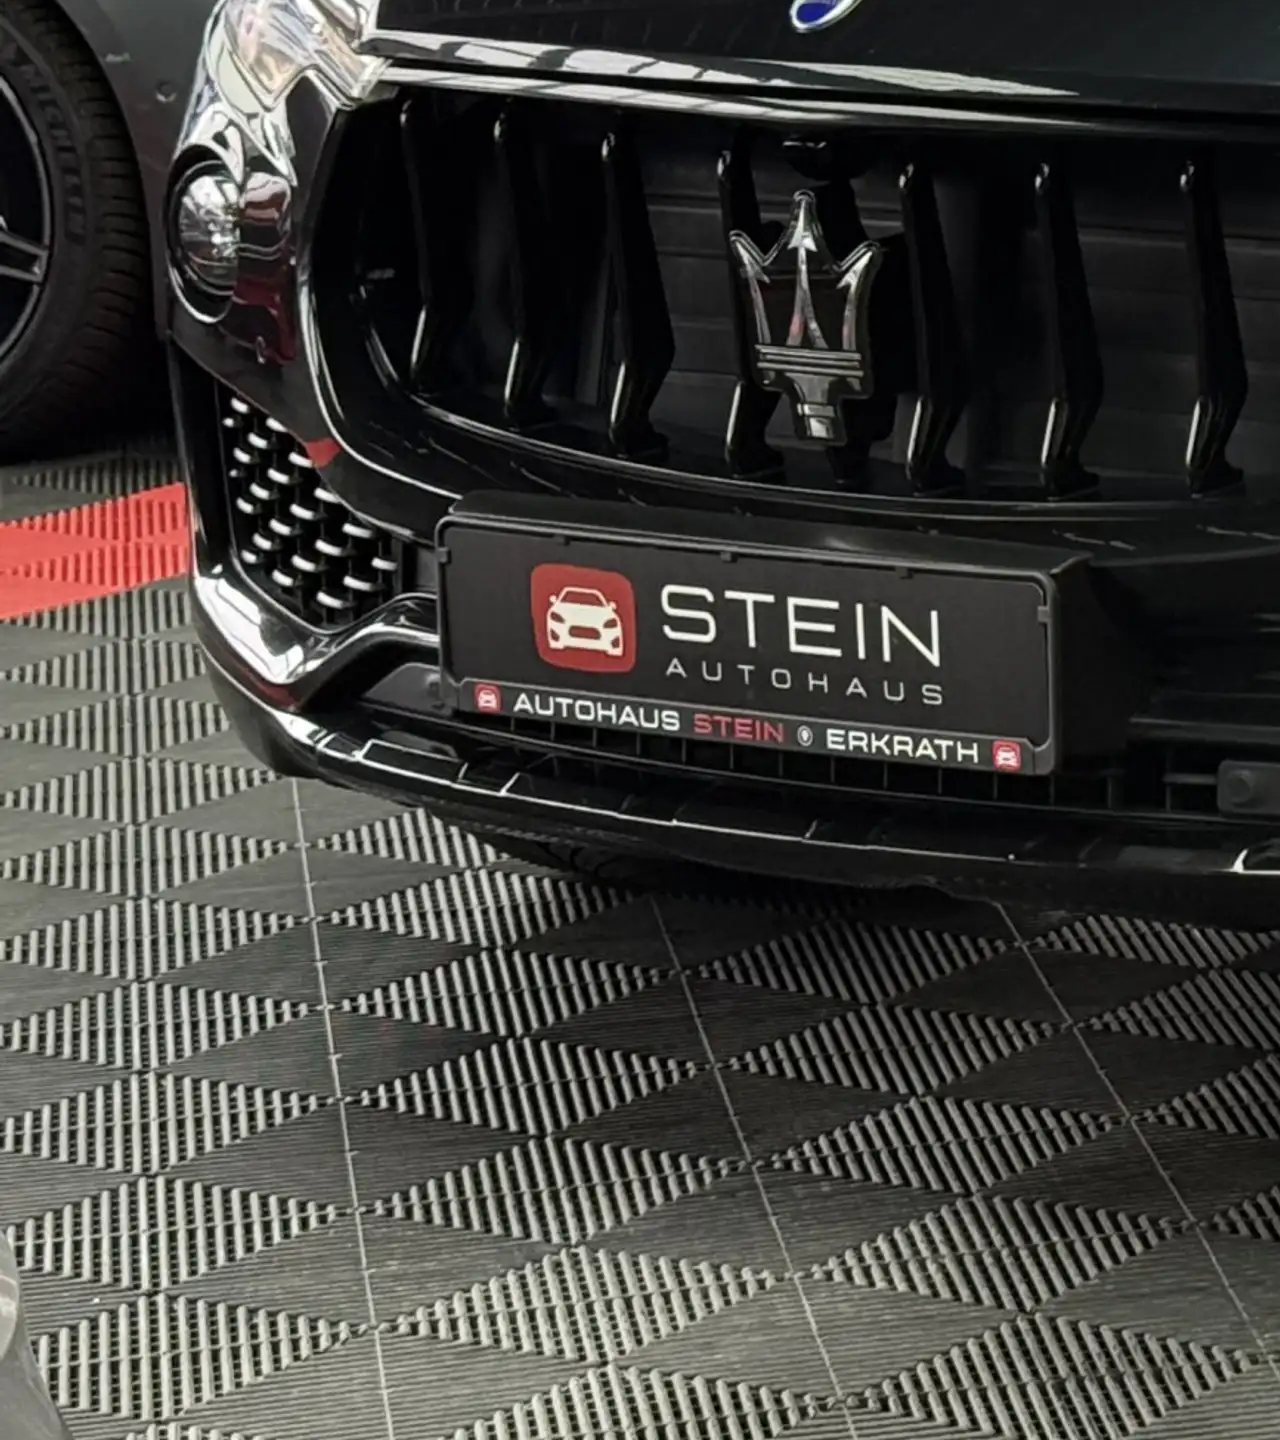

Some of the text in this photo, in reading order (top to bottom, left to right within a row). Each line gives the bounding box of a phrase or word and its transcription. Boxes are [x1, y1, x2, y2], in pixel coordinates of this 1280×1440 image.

[661, 584, 940, 667] STEIN
[666, 657, 943, 705] AUTOHAUS
[513, 692, 979, 764] AUTOHAUS STEIN ERKRATH
